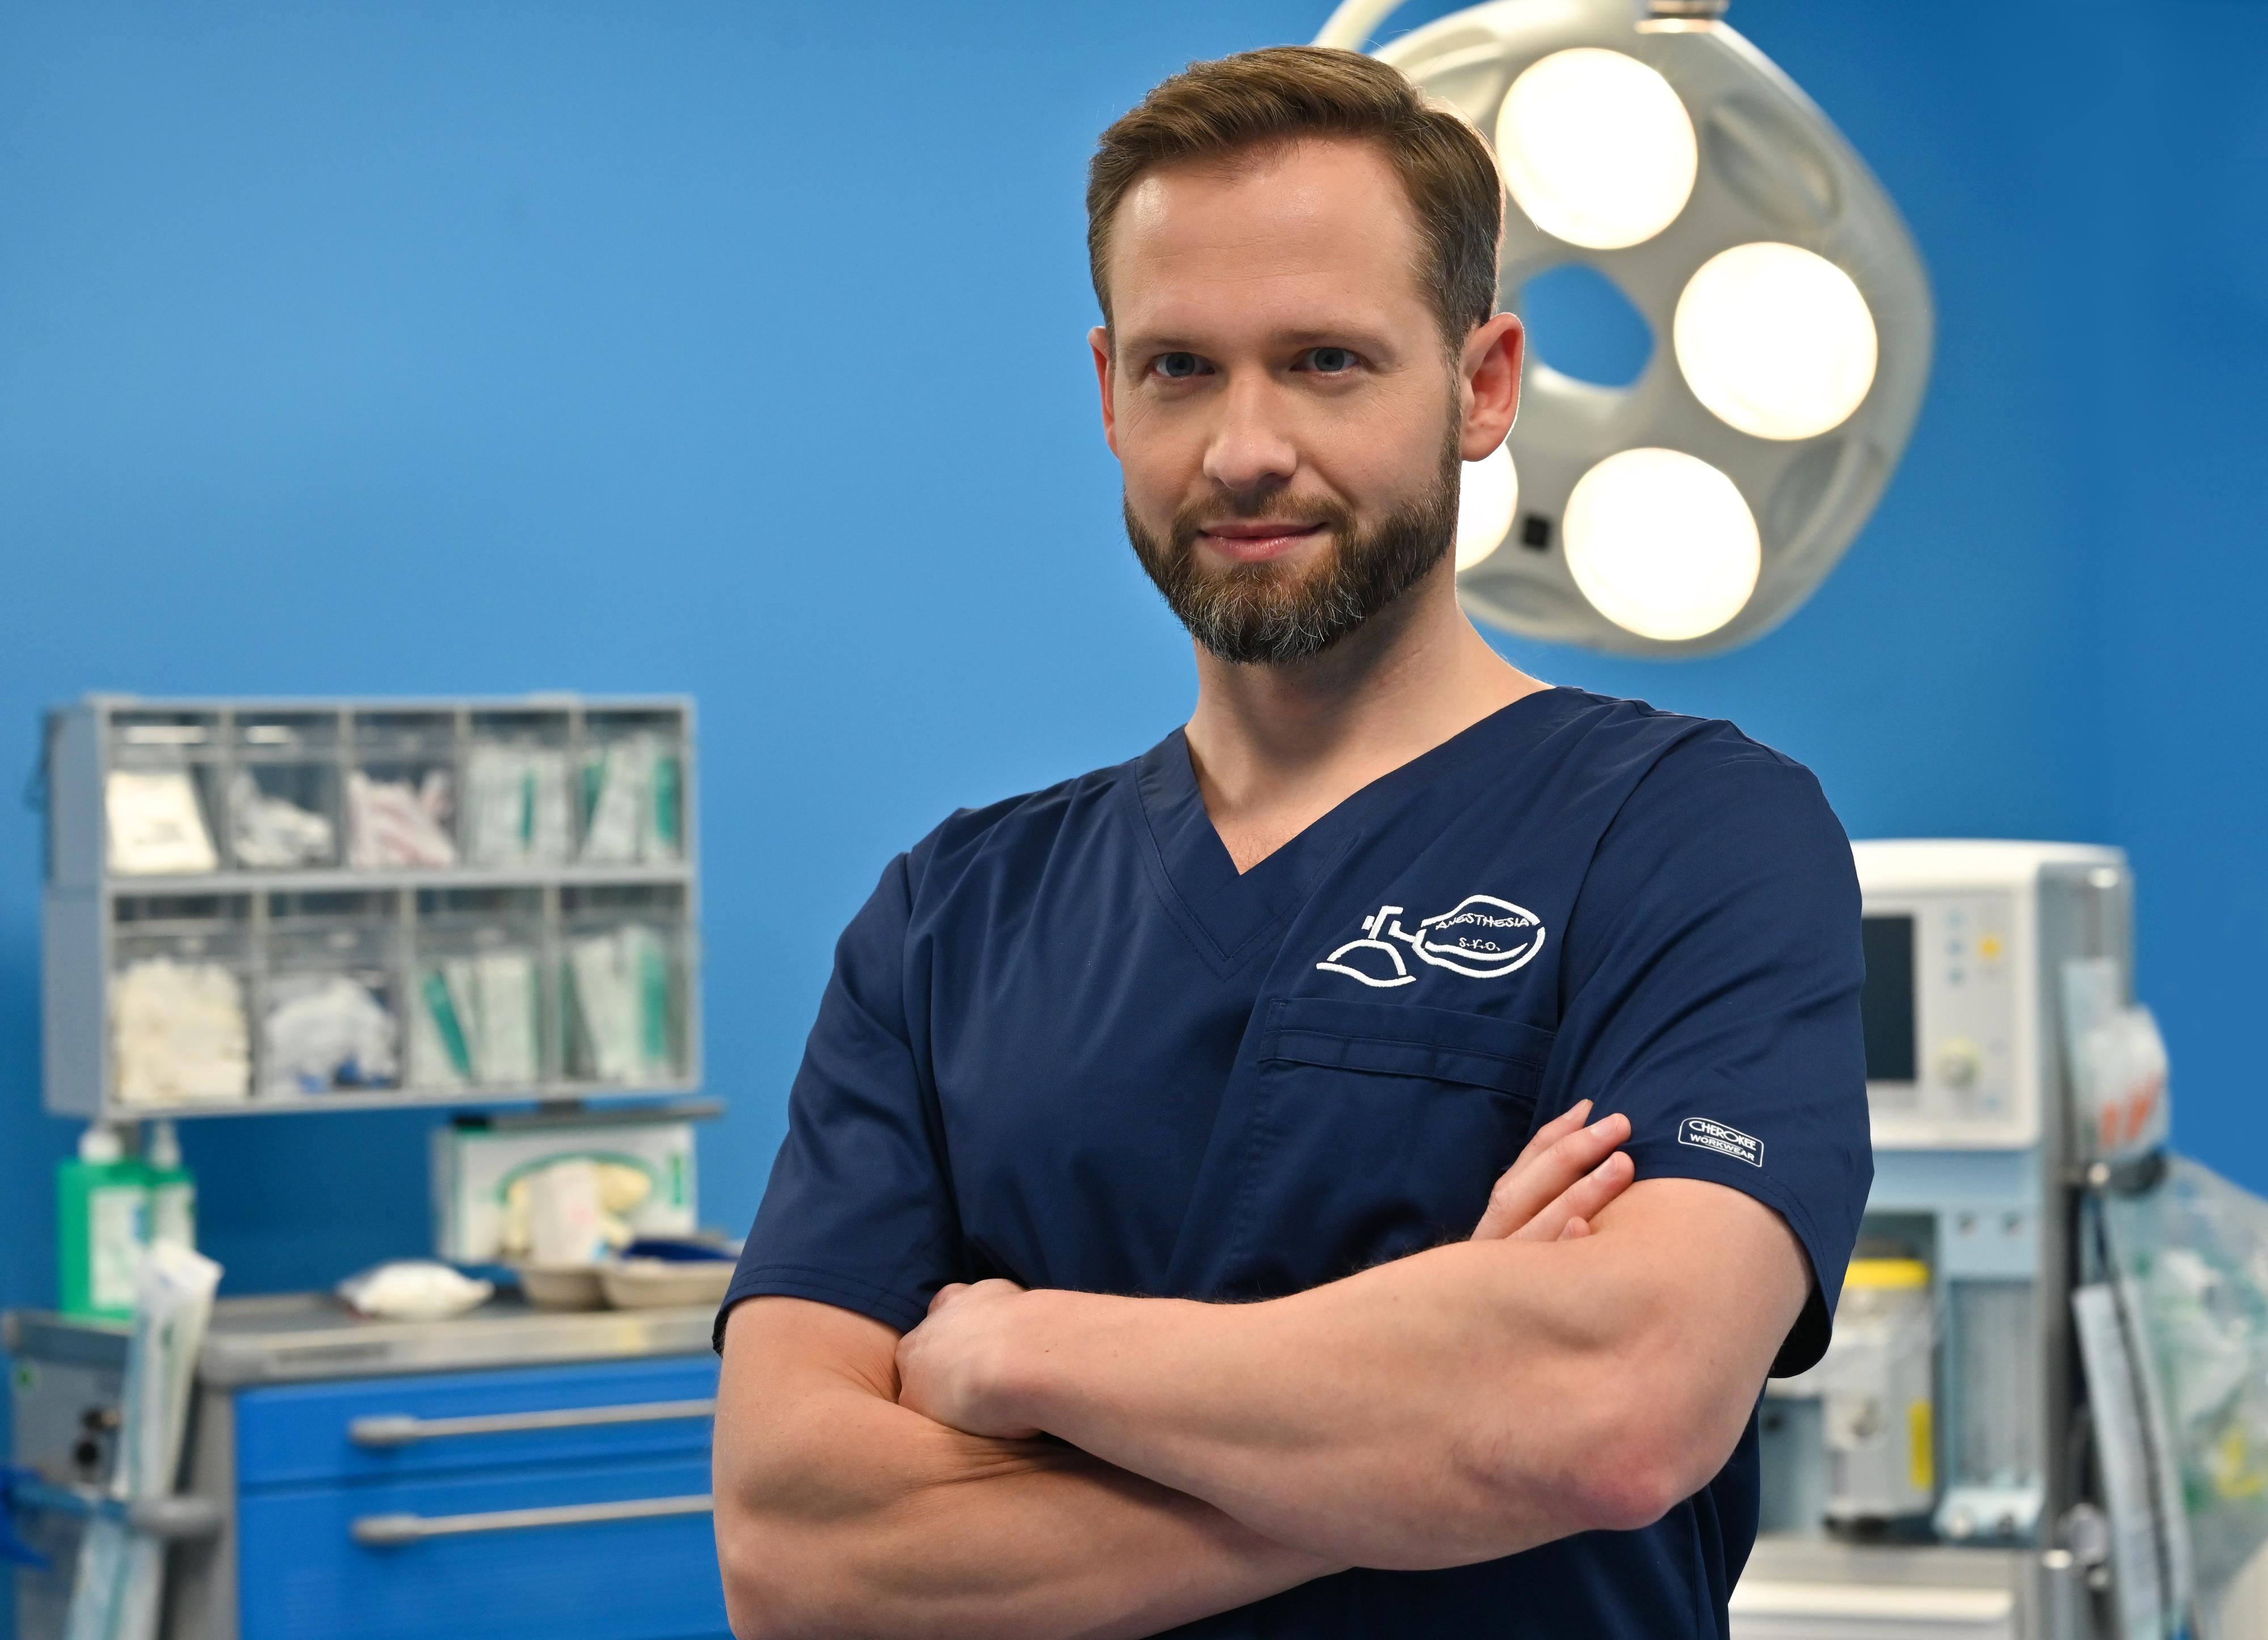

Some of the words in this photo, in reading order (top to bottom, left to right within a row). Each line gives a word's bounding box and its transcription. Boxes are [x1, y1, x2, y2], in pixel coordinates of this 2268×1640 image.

[1435, 913, 1529, 930] ANESTHESIA
[1689, 1120, 1757, 1151] CHEROKEE
[1690, 1133, 1755, 1161] WORKWEAR
